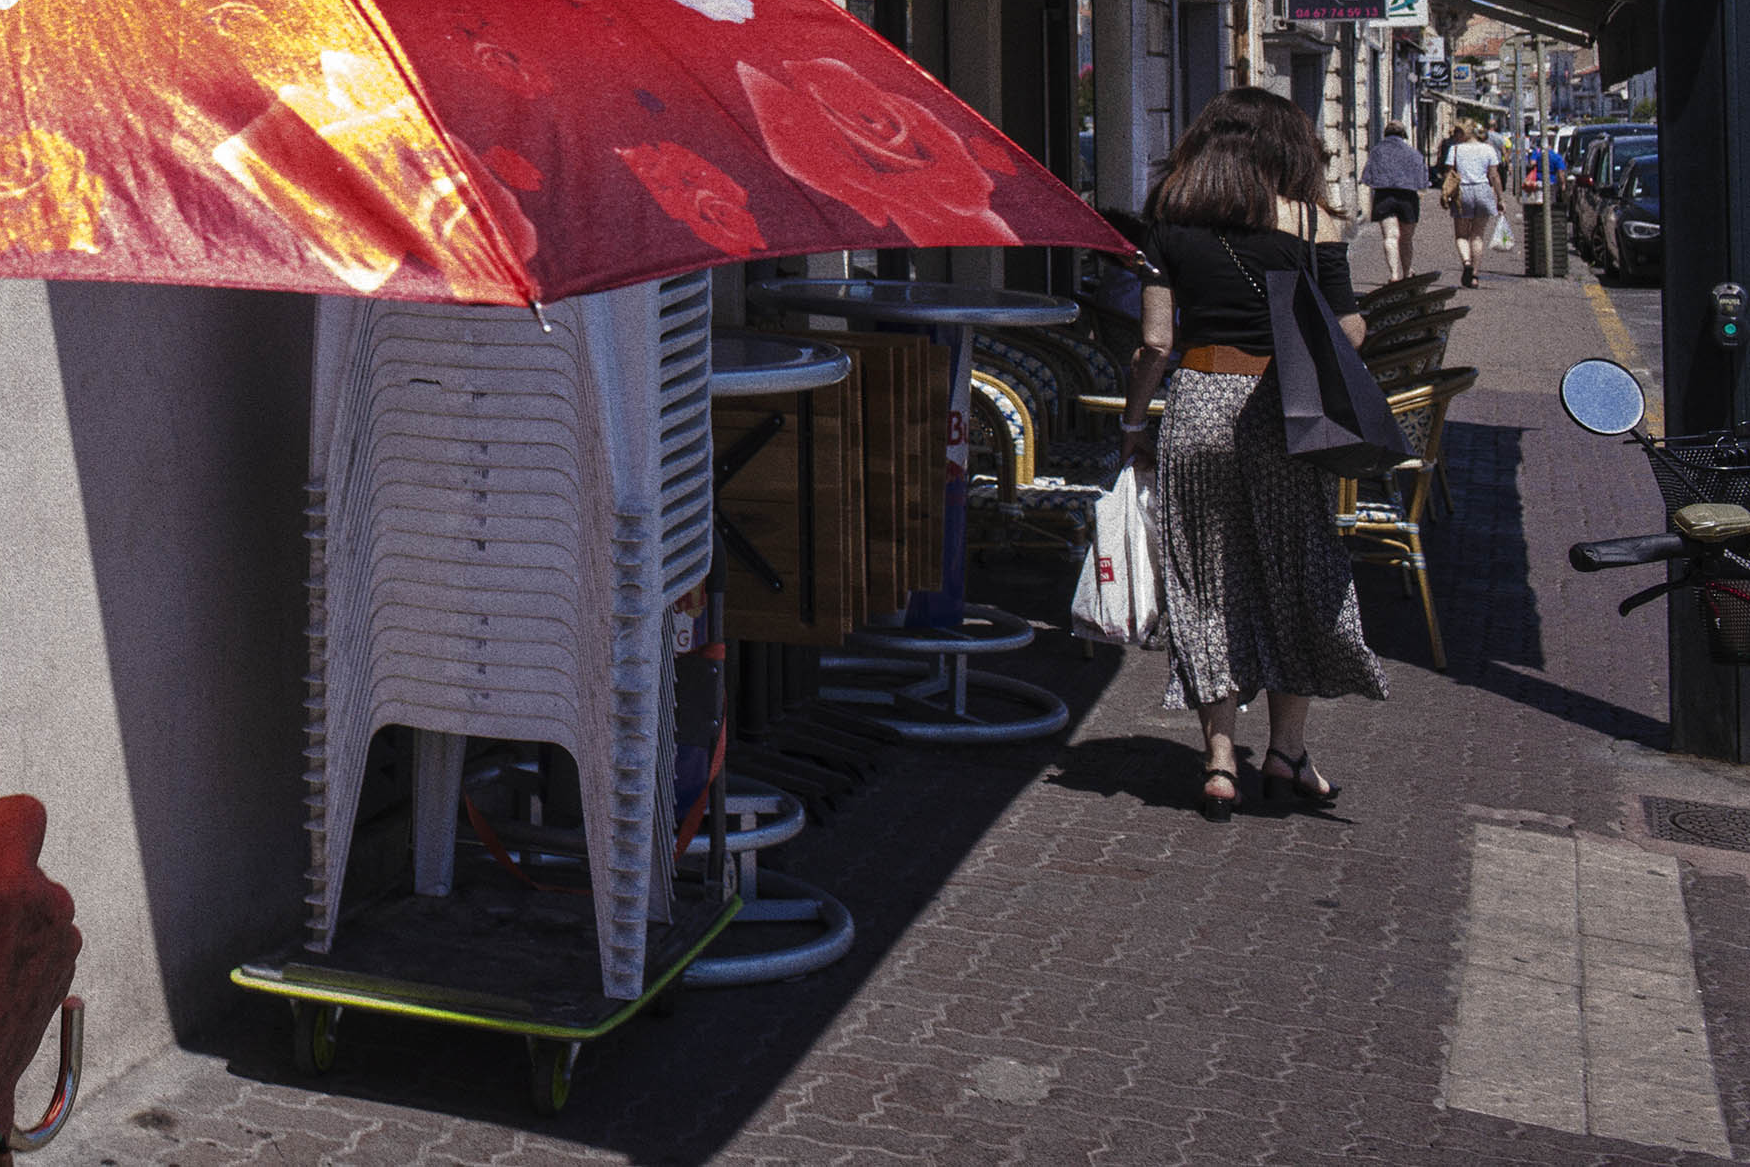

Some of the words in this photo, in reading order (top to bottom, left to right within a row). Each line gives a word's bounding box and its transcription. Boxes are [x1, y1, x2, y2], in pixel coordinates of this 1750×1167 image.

[1295, 8, 1310, 18] 04
[1313, 8, 1327, 18] 67
[1330, 8, 1344, 18] 74
[1365, 7, 1379, 17] 13
